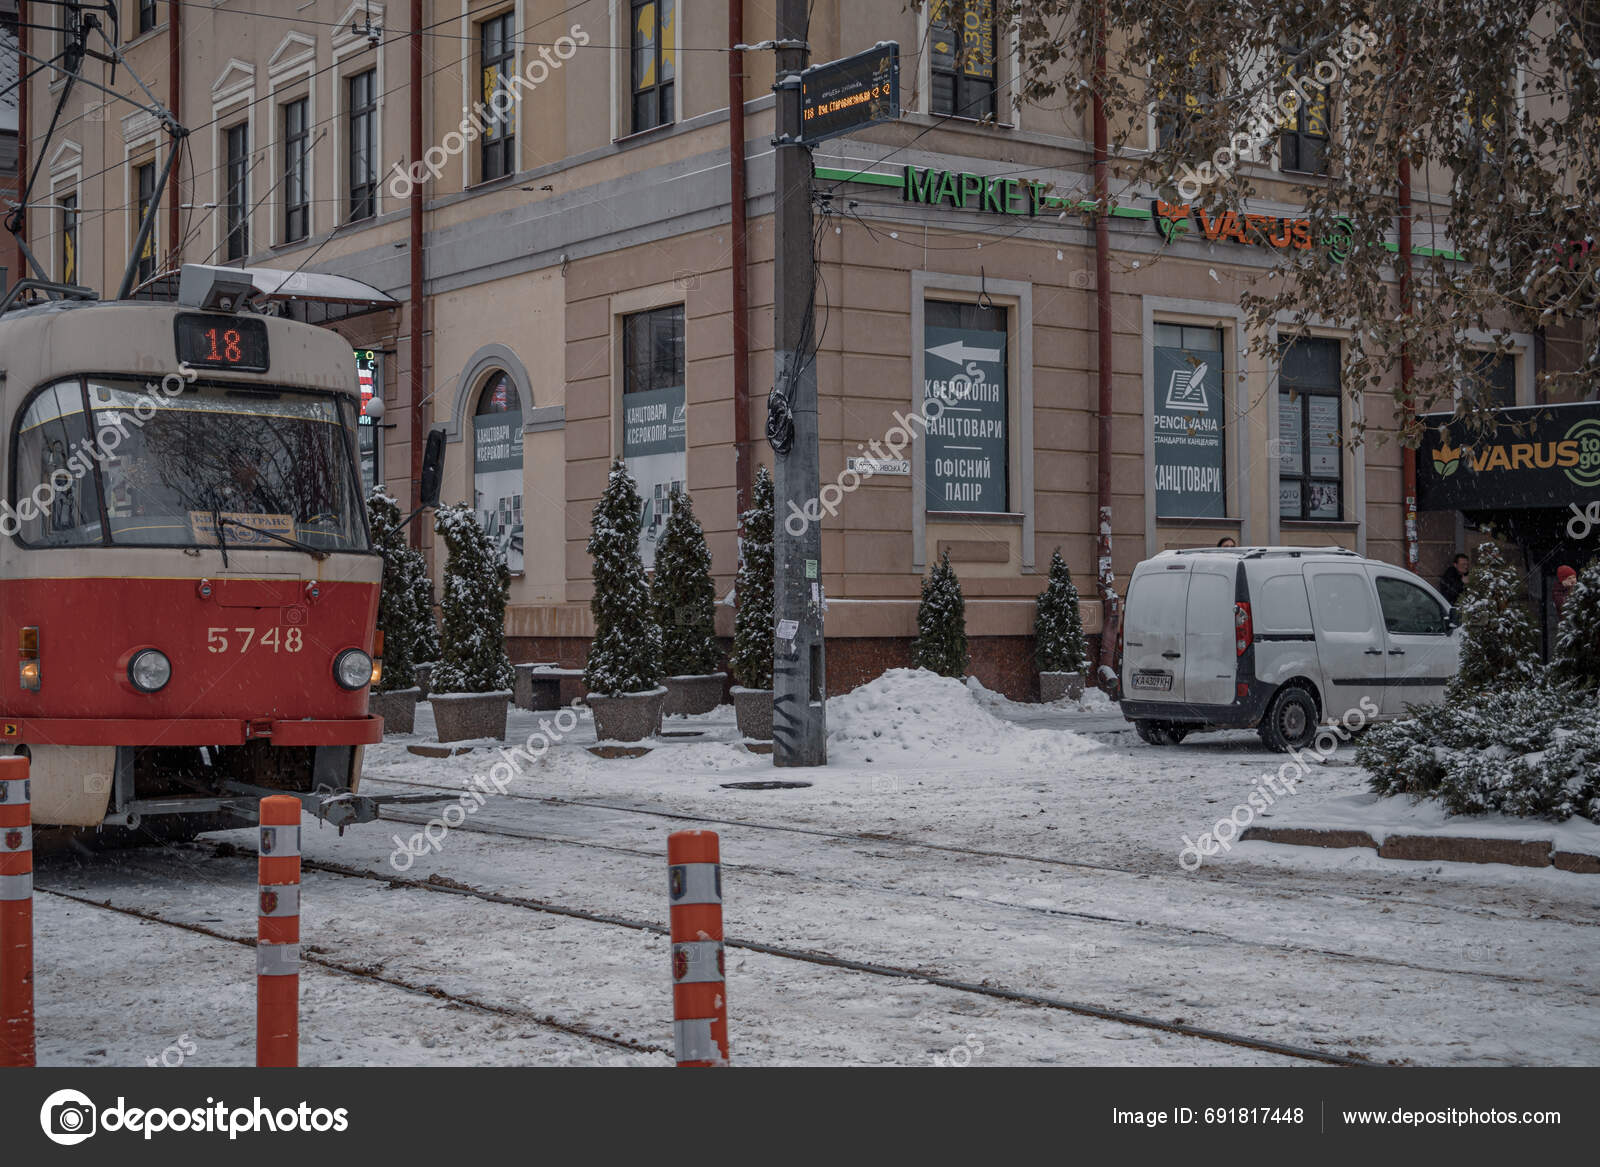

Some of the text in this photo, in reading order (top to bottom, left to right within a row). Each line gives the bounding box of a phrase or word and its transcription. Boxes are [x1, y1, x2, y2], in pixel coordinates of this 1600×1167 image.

[904, 165, 1046, 216] МАРКЕТ
[205, 328, 241, 362] 18
[925, 379, 1000, 402] КСЕРОКОПІЯ
[627, 403, 667, 424] КАНЦТОВАРИ
[627, 424, 667, 444] КСЕРОКОПІЯ
[1465, 440, 1580, 472] VARUS
[935, 457, 991, 479] ОФІСНИЙ
[945, 483, 982, 501] ПАПІР
[208, 627, 303, 653] 5748
